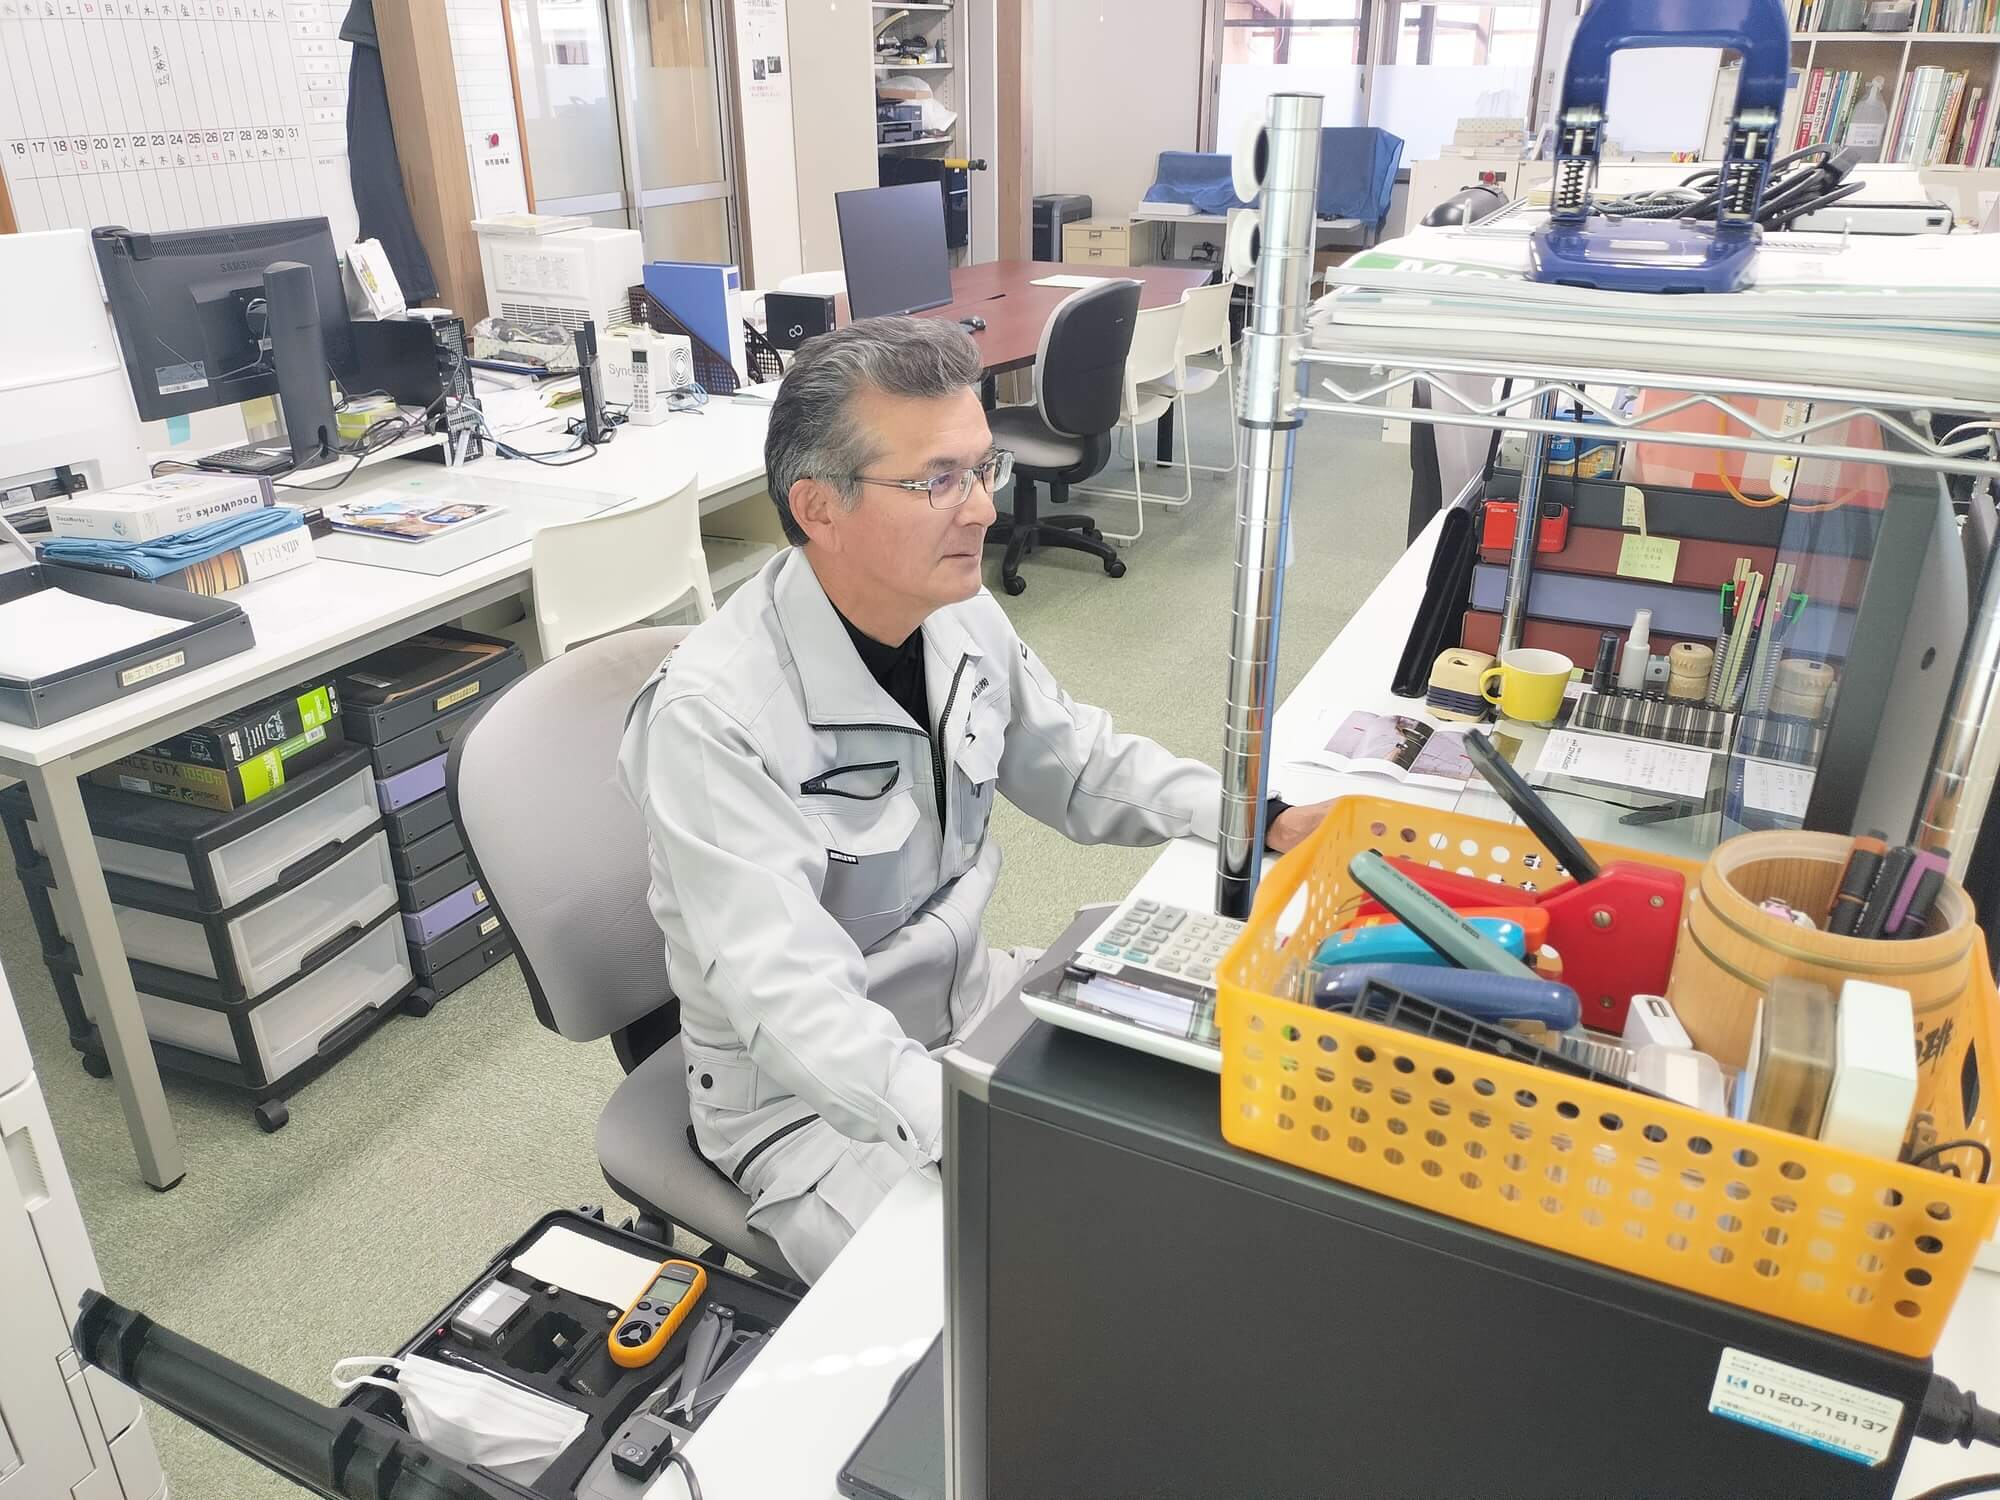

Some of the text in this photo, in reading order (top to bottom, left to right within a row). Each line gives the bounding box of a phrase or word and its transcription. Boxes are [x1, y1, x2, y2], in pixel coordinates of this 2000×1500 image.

[11, 128, 299, 154] 16 17 18 19 20 21 22 23 24 25 26 27 28 29 30 31
[177, 494, 258, 523] DocuWorks 6.2
[227, 731, 244, 761] ASUS
[152, 760, 180, 777] GTX
[182, 766, 212, 784] 1050
[1752, 1383, 1889, 1434] 0120-718137
